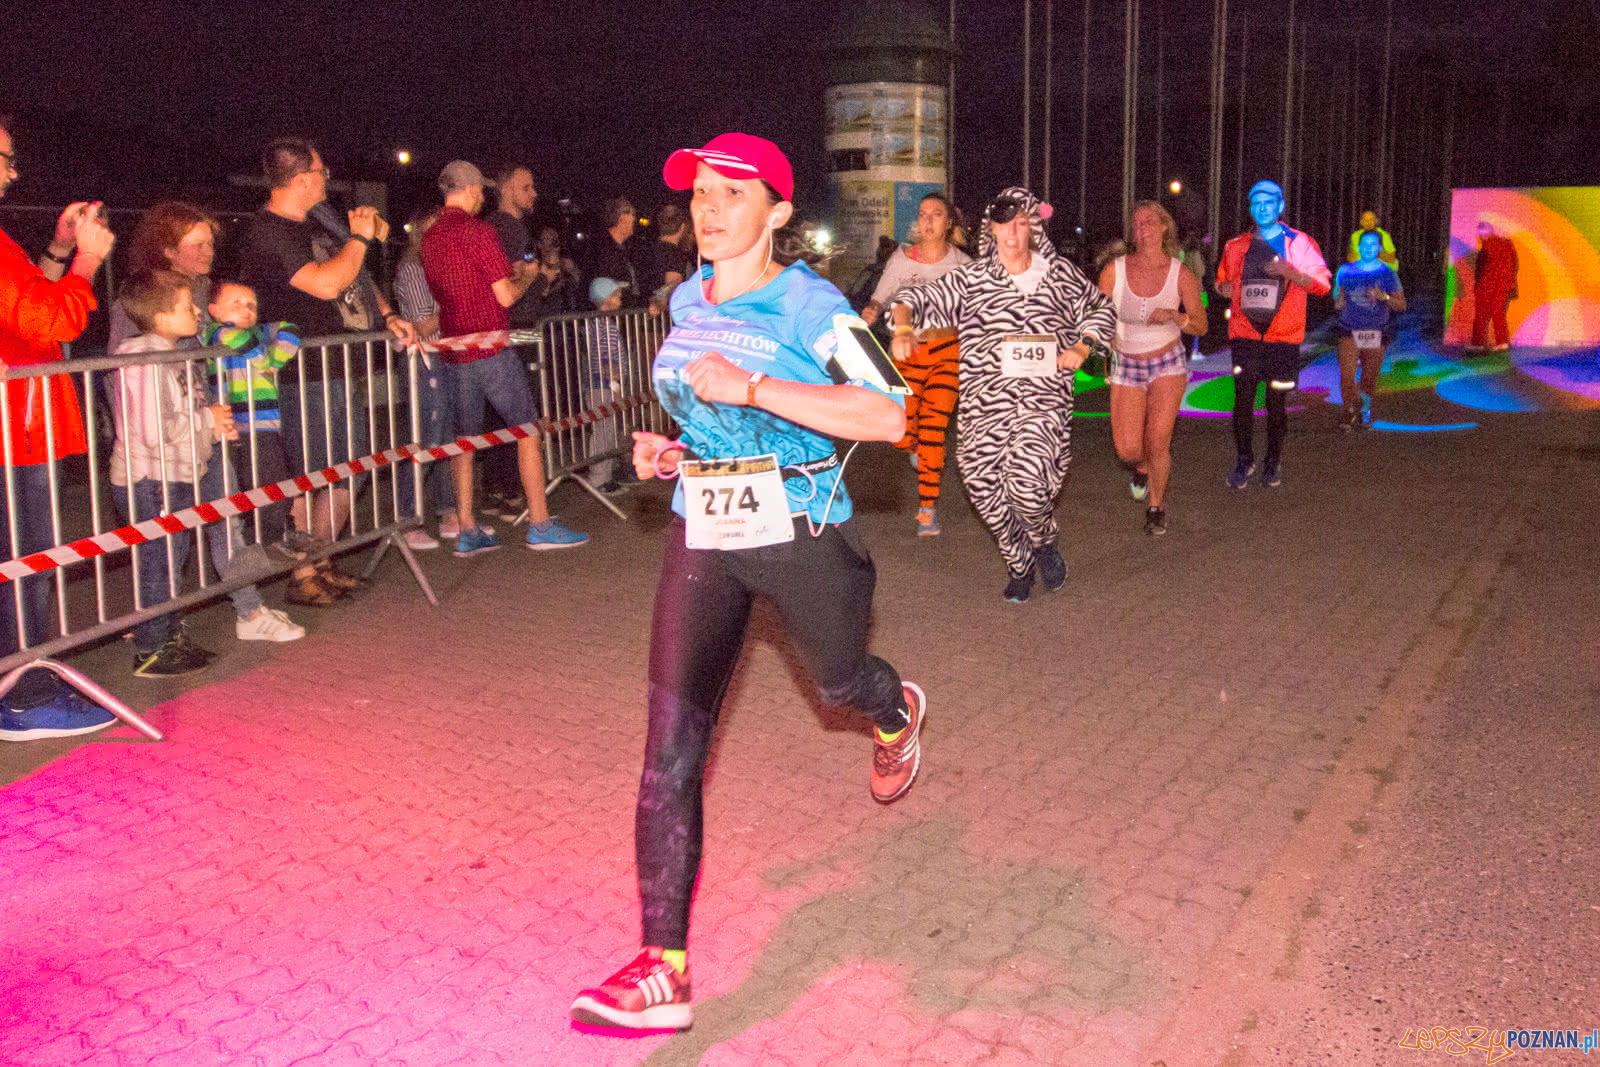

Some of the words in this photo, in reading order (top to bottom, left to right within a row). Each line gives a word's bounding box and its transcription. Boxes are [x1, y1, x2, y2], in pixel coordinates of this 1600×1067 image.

[1246, 287, 1269, 298] 696
[703, 329, 781, 354] LECHITÓW
[1012, 346, 1046, 361] 549
[701, 485, 760, 516] 274
